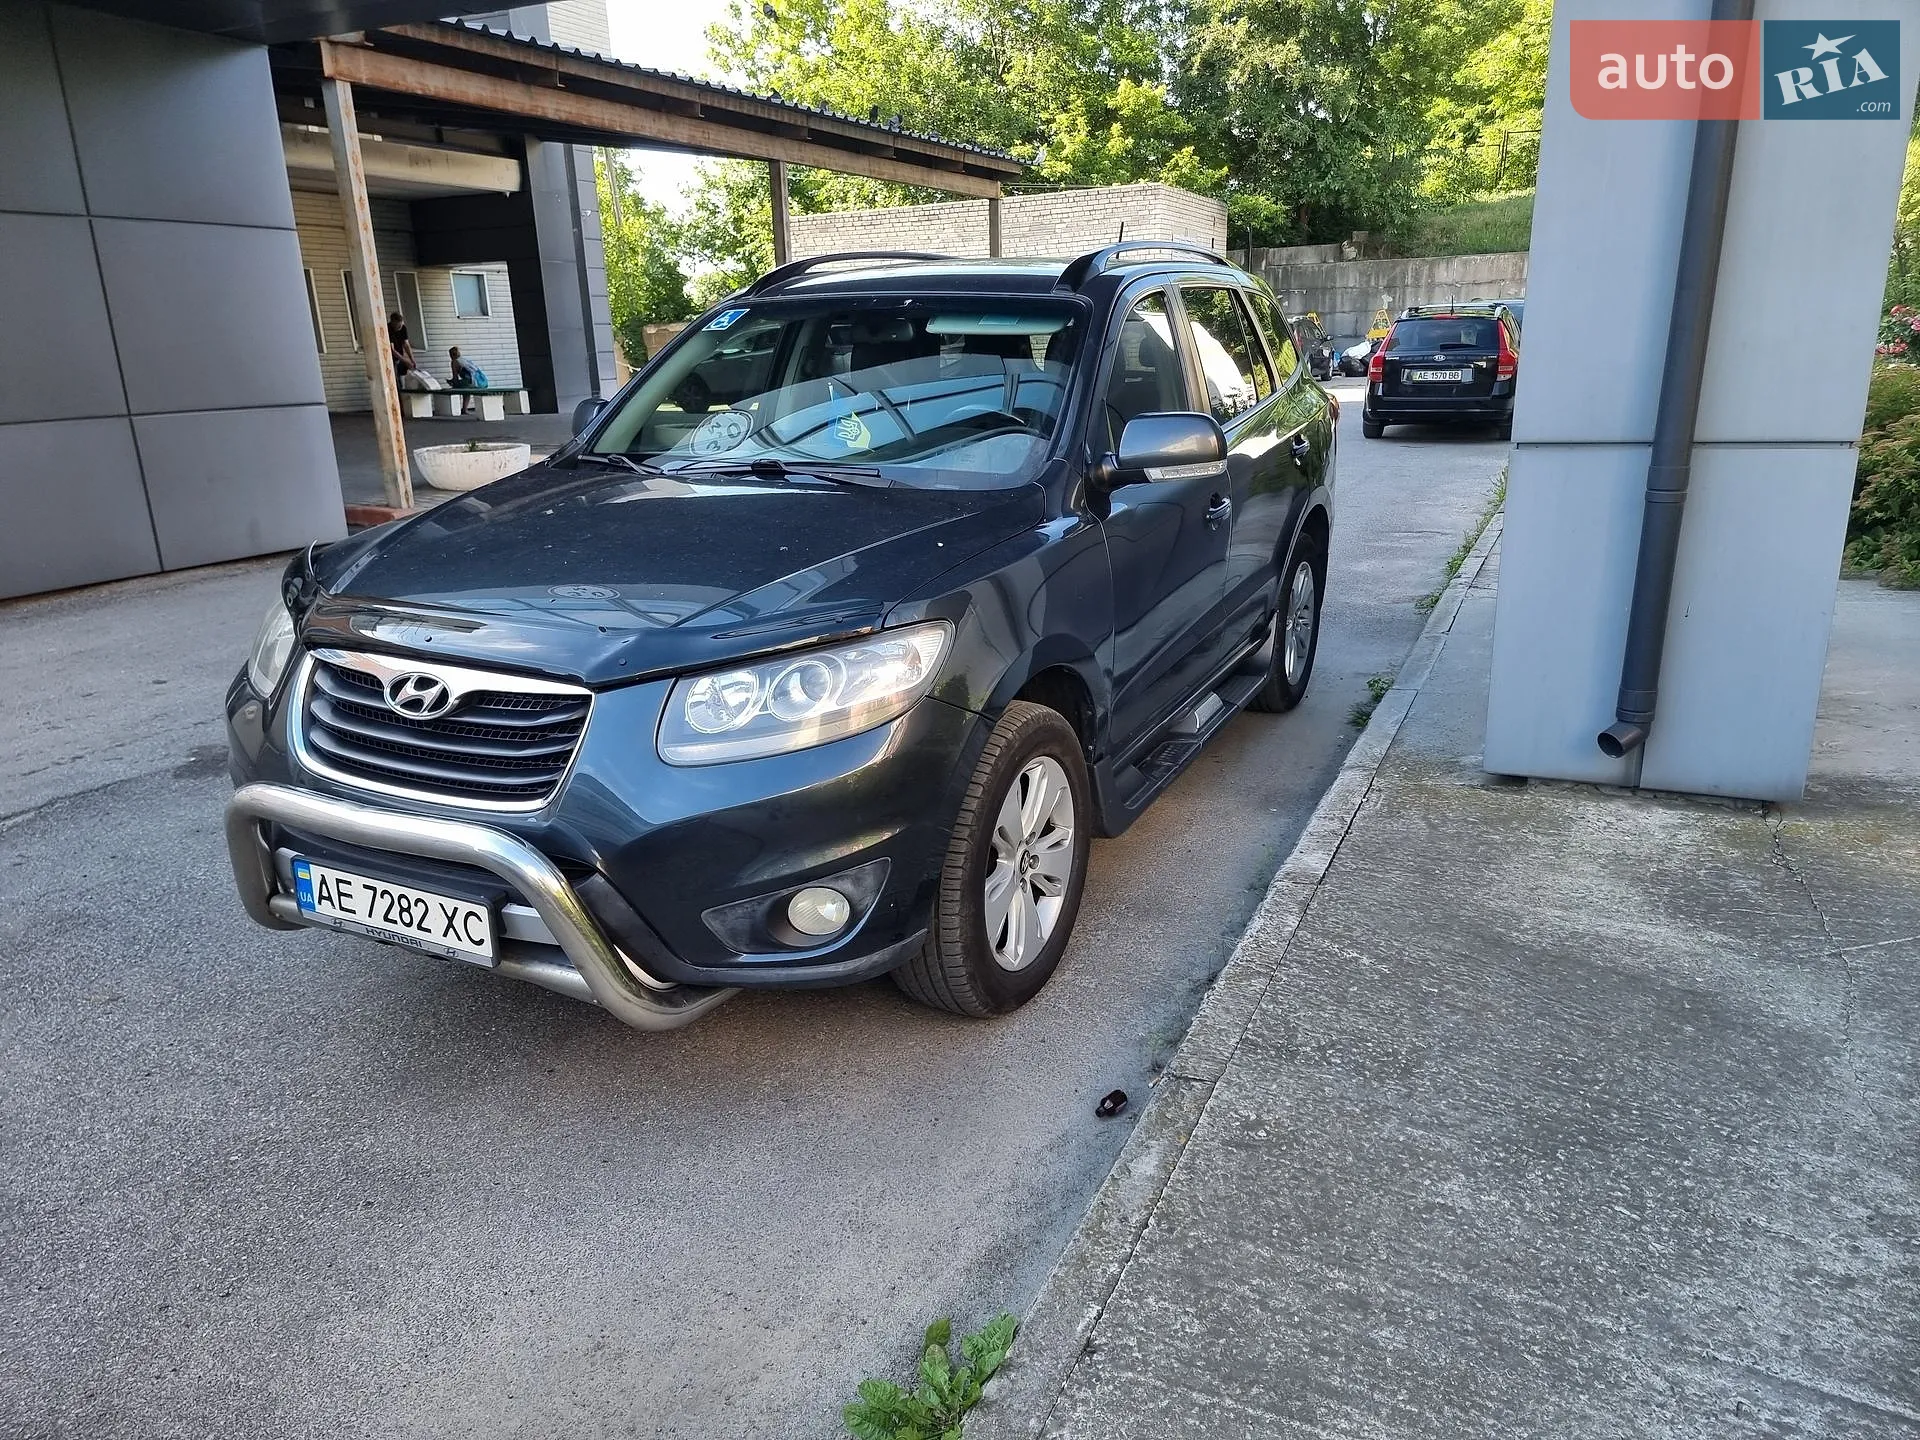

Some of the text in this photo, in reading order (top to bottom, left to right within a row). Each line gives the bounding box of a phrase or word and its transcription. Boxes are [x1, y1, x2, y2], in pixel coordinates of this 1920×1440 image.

[300, 893, 313, 904] UA
[317, 873, 485, 947] AE 7282 XC
[365, 927, 423, 949] HYUNDAI
